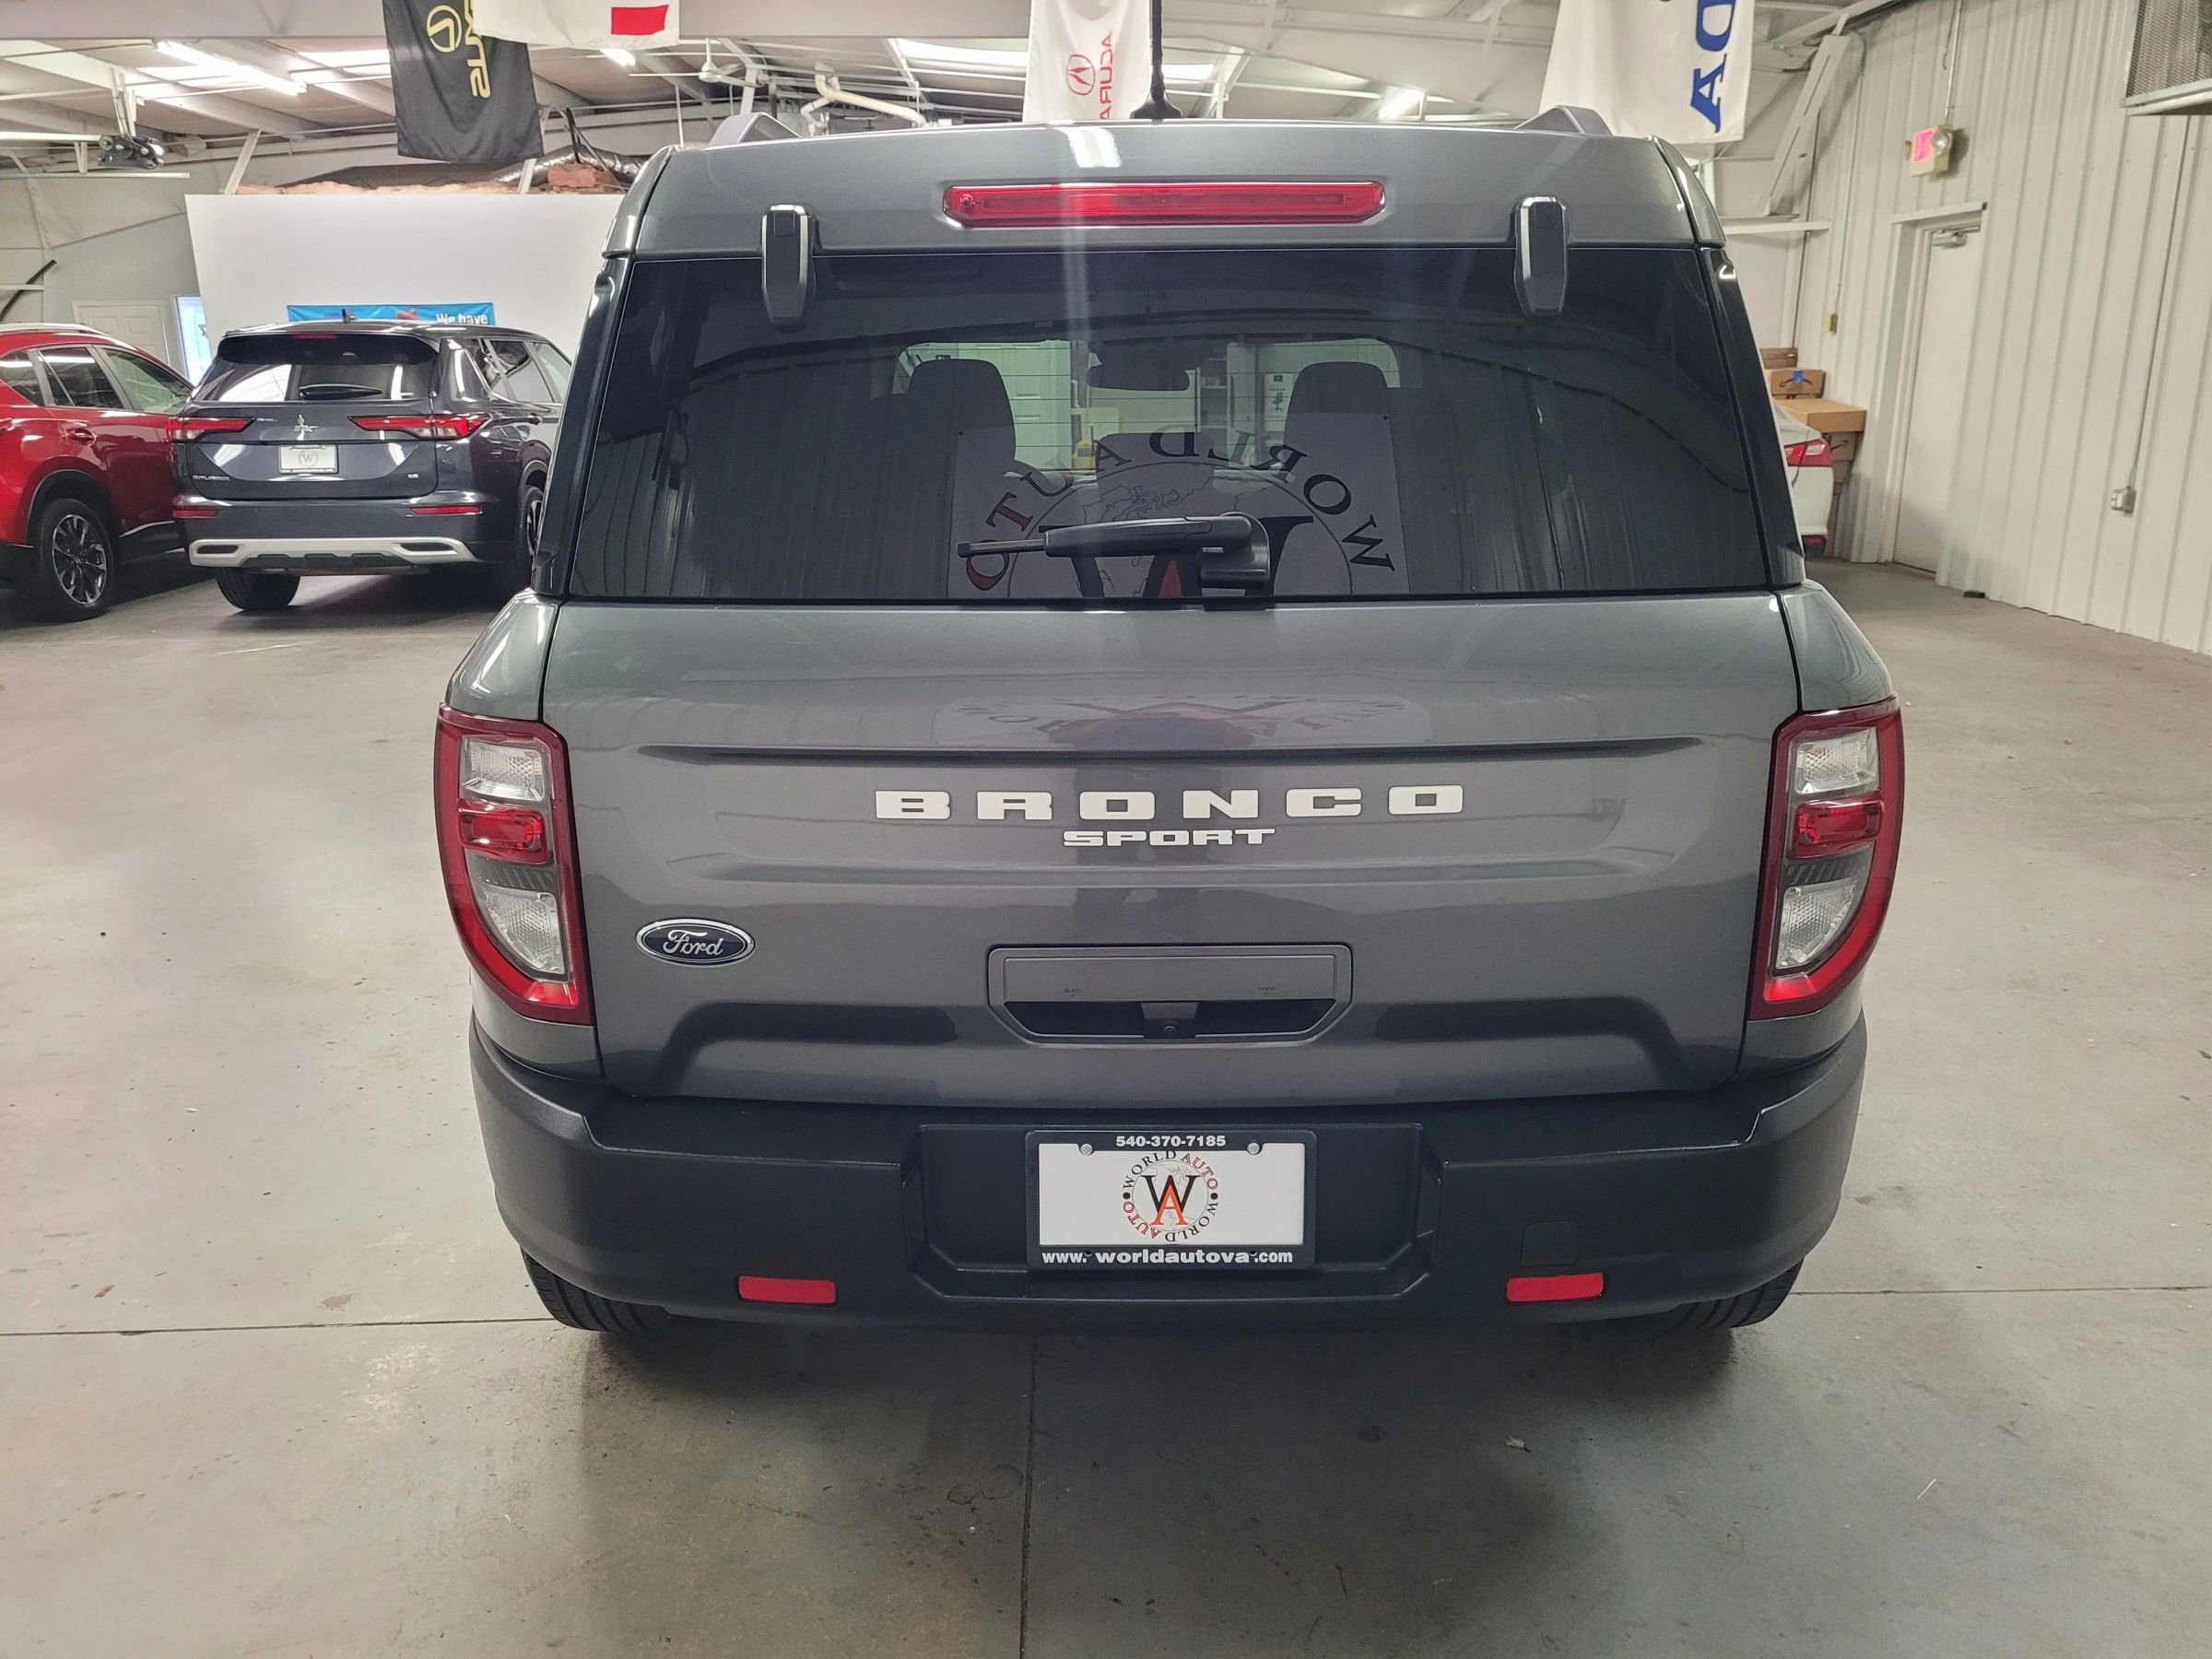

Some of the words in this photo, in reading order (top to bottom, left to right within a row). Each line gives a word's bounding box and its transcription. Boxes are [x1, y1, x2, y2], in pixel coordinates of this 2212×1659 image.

[457, 312, 488, 324] have
[875, 784, 1465, 820] BRONCO
[1063, 828, 1276, 847] SPORT
[662, 929, 725, 956] Ford
[1115, 1135, 1227, 1147] 540-370-7185
[1123, 1150, 1177, 1189] WORLD
[1180, 1153, 1219, 1190] AUTO
[1123, 1201, 1161, 1240] AUTO
[1164, 1201, 1219, 1242] WORLD
